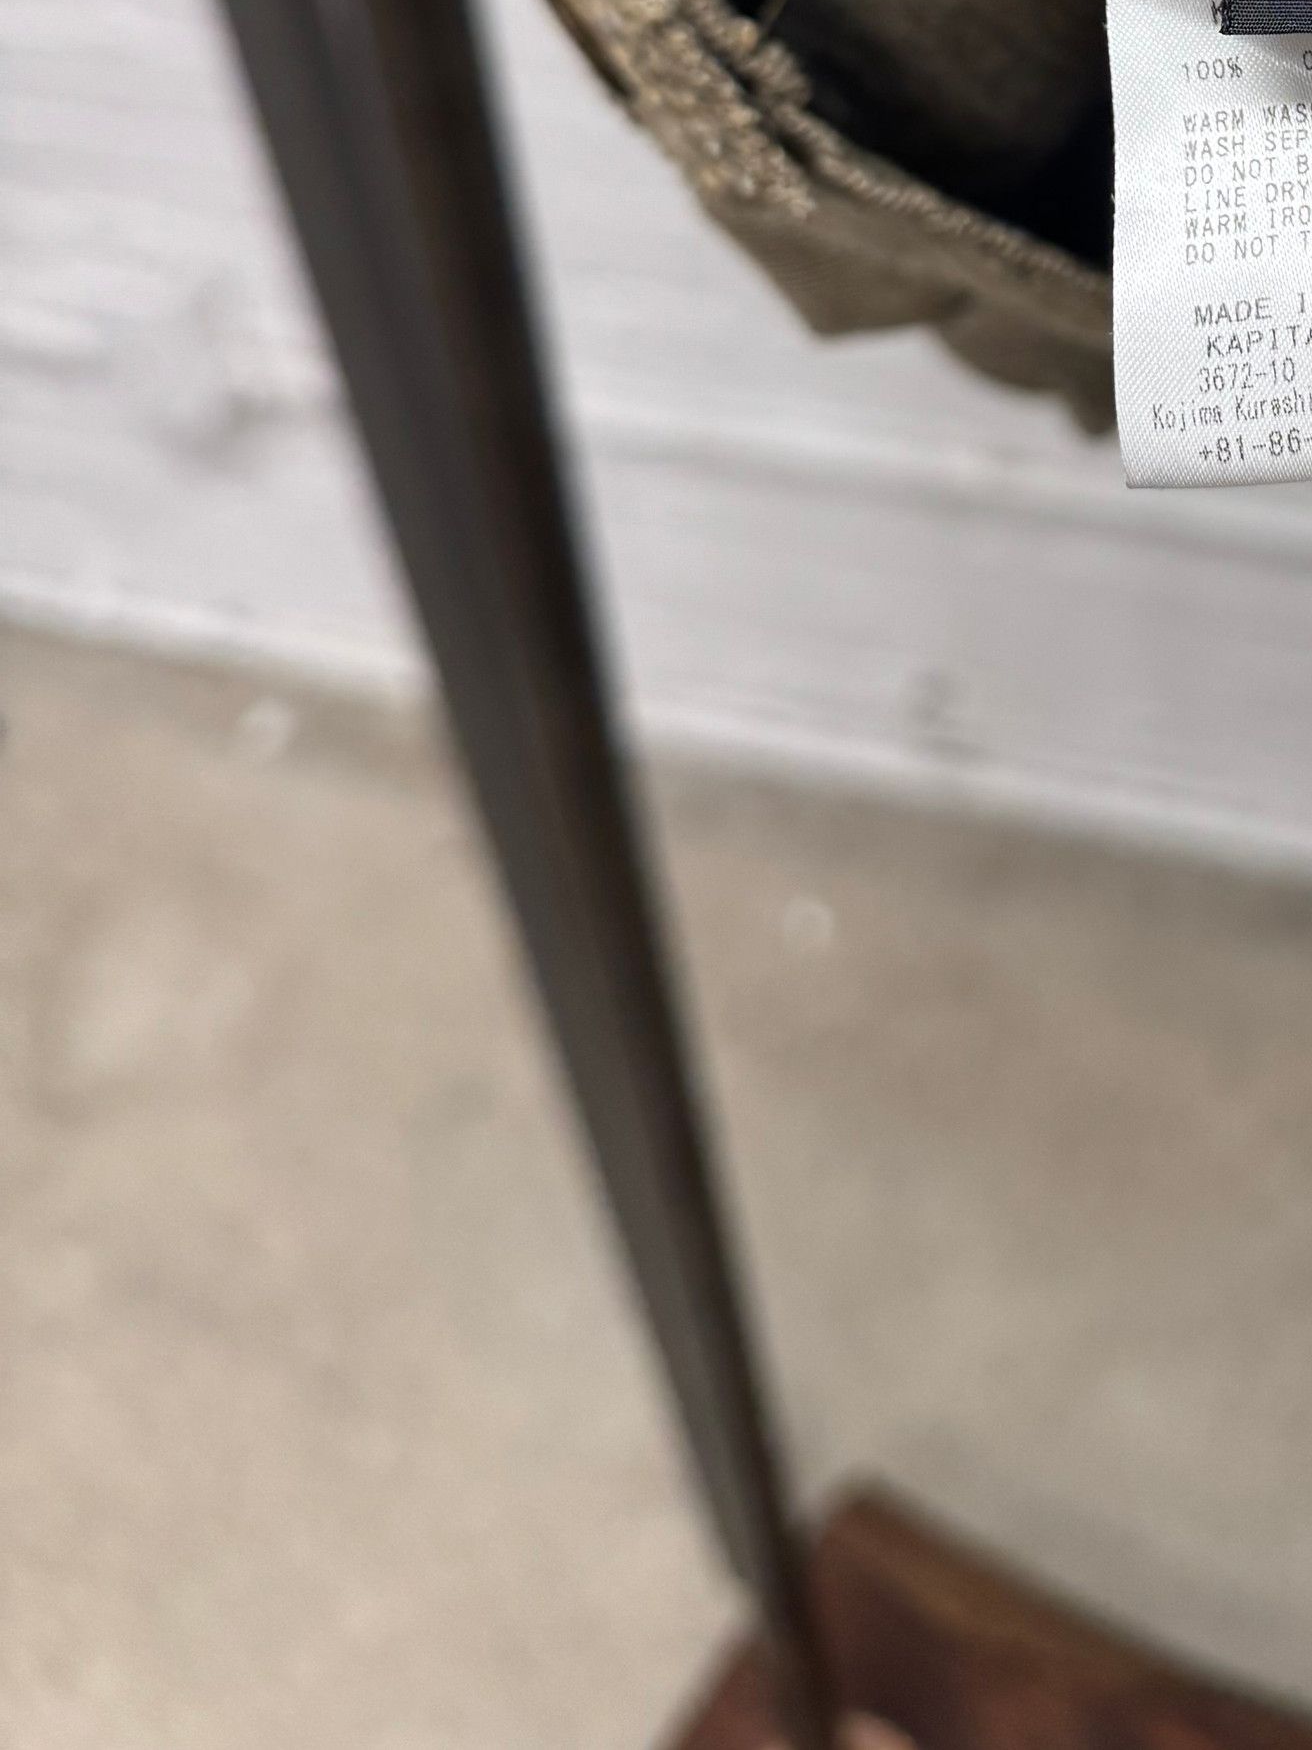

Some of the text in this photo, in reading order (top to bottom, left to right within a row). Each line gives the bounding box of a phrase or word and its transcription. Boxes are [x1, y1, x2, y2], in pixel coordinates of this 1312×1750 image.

[1180, 56, 1243, 81] 100%
[1183, 109, 1244, 134] WARM
[1184, 135, 1245, 161] WASH
[1185, 164, 1214, 187] DO
[1232, 157, 1278, 182] NOT
[1185, 186, 1246, 213] LINE
[1265, 180, 1309, 204] DRY
[1185, 214, 1247, 240] WARM
[1186, 243, 1215, 266] DO
[1234, 235, 1279, 260] NOT
[1194, 297, 1273, 327] MADE
[1199, 356, 1296, 393] 3672-10
[1153, 401, 1223, 432] Kojima
